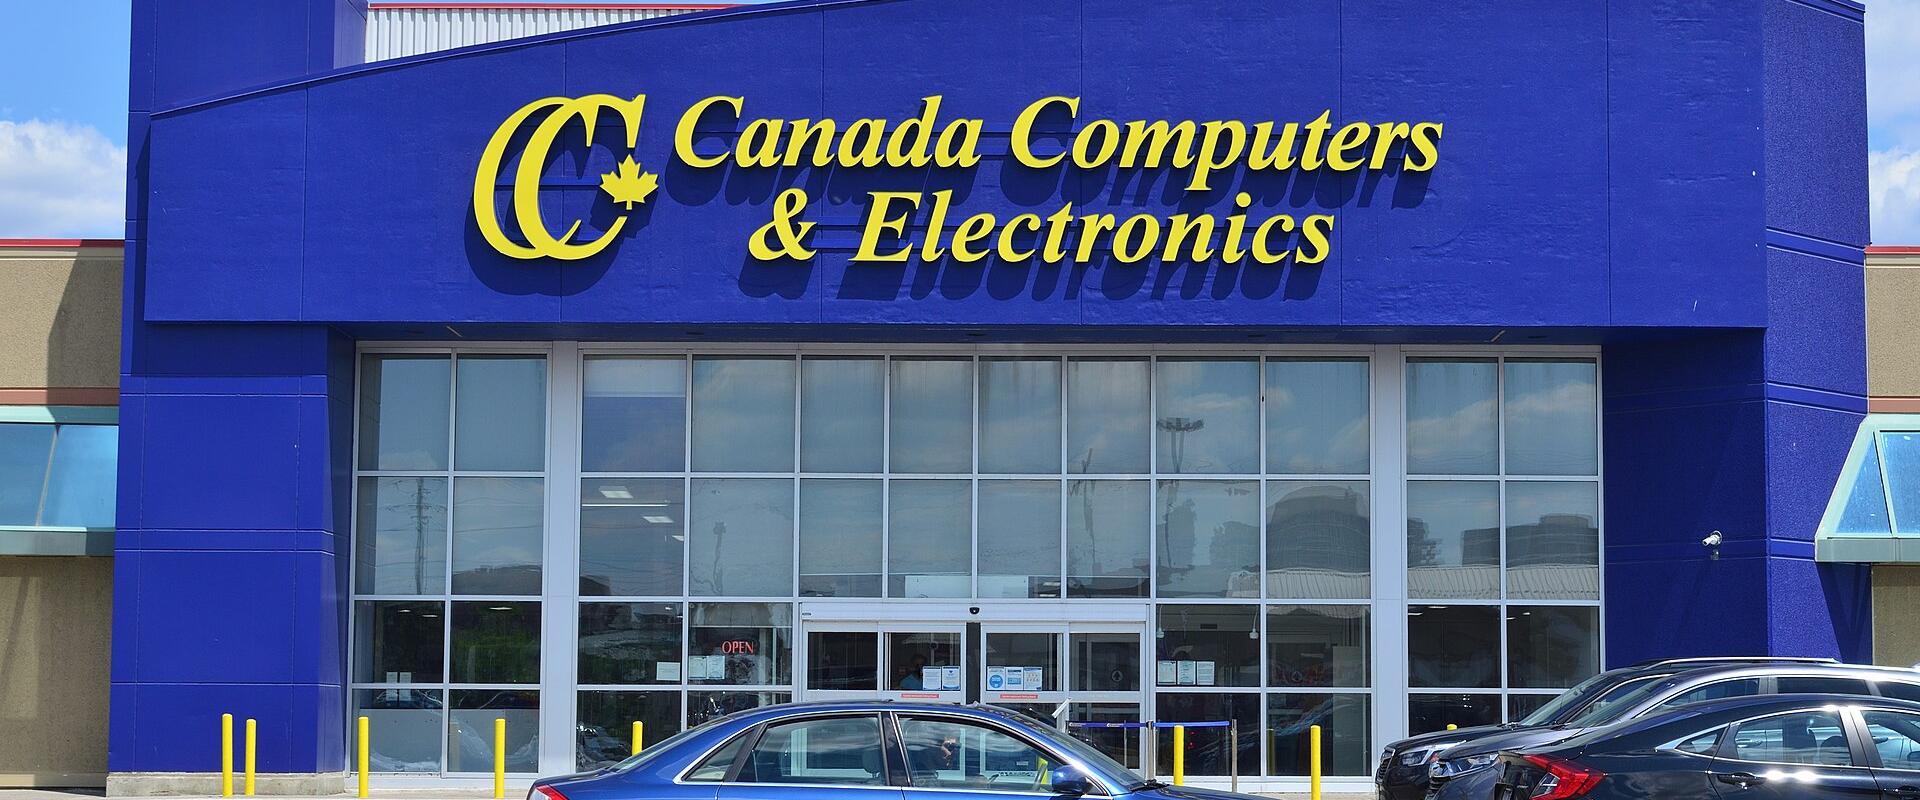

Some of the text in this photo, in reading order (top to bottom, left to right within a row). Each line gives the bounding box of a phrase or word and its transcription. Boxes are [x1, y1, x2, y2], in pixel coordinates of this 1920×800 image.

[674, 95, 1443, 191] Canada Computers
[748, 188, 1335, 263] & Electronics
[722, 640, 754, 654] OPEN
